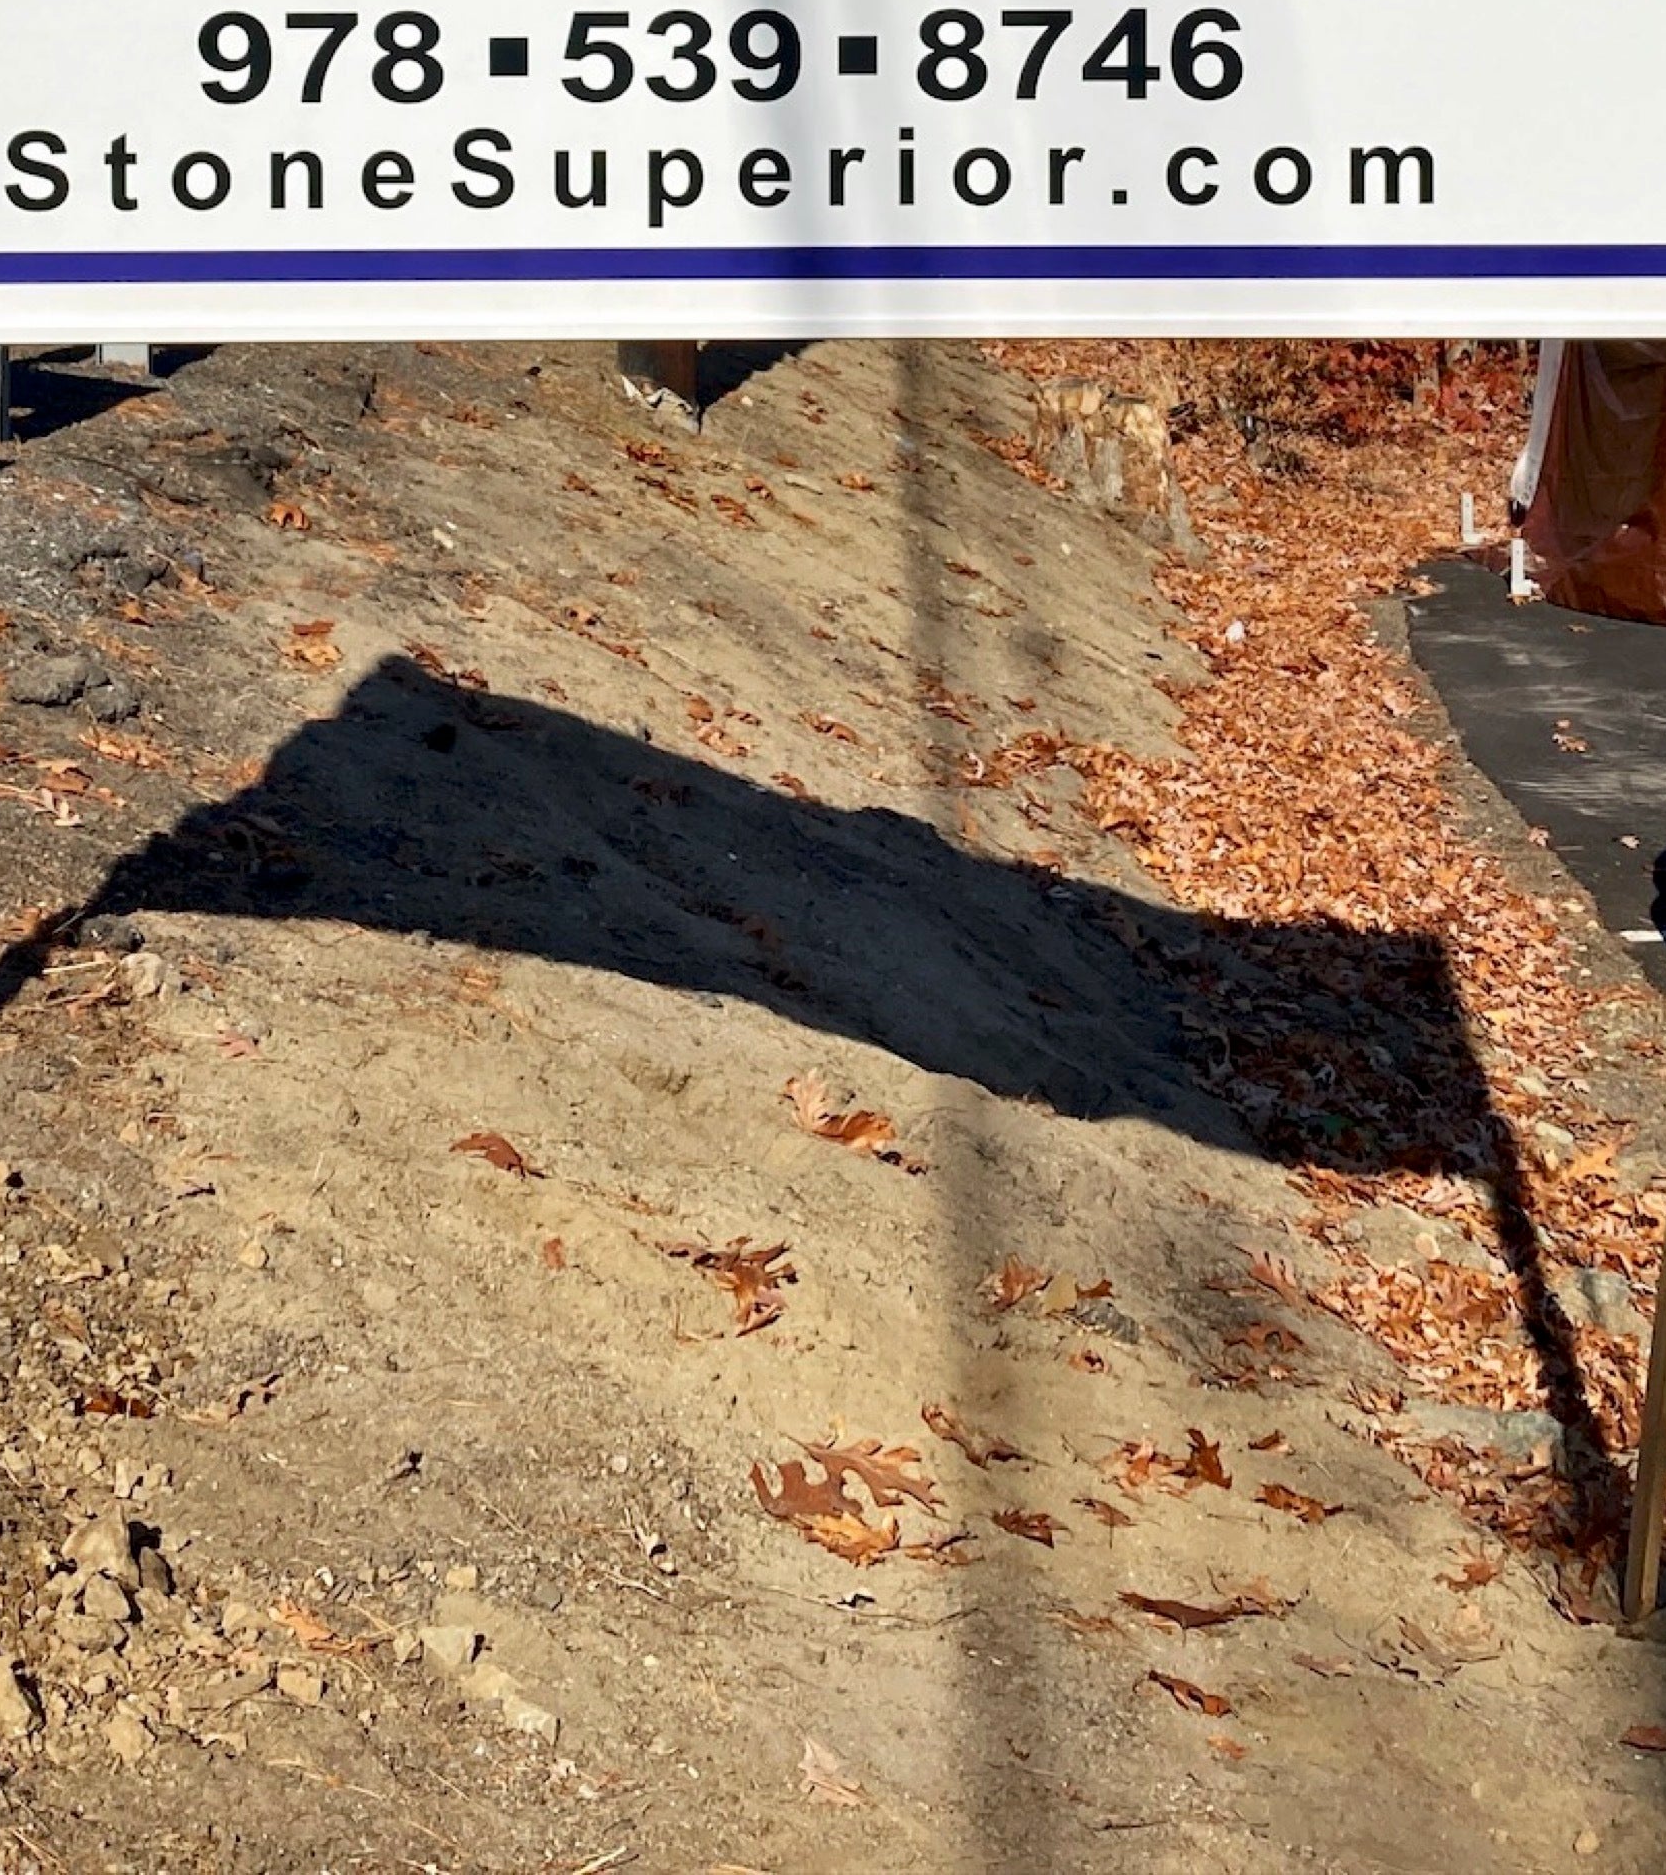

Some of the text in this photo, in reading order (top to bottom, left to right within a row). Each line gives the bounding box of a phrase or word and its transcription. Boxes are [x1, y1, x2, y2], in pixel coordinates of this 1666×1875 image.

[197, 7, 1244, 106] 978 539 8746
[4, 125, 1435, 230] StoneSuperior.com
